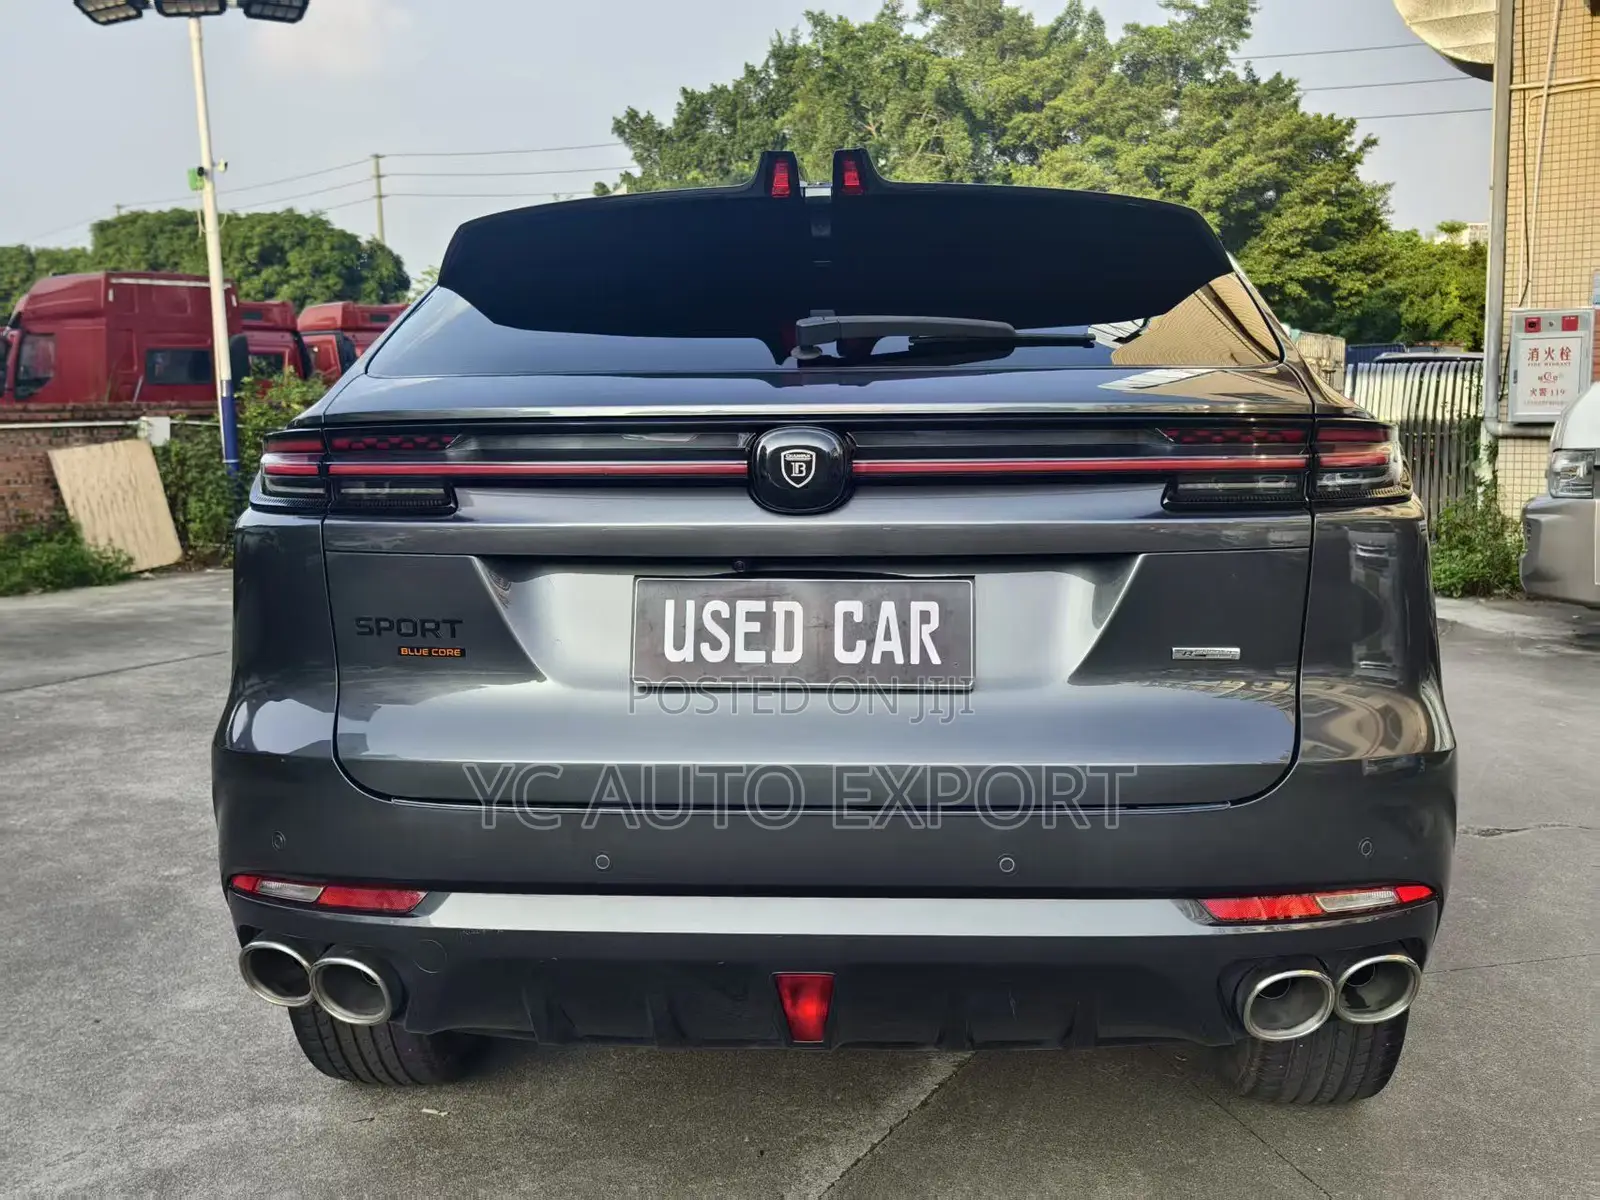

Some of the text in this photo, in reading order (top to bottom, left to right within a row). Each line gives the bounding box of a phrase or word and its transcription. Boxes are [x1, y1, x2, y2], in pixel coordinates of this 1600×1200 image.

[1527, 346, 1572, 361] 消火栓
[355, 616, 464, 639] SPORT
[664, 599, 942, 665] USED CAR
[400, 647, 461, 657] BLUE CORE
